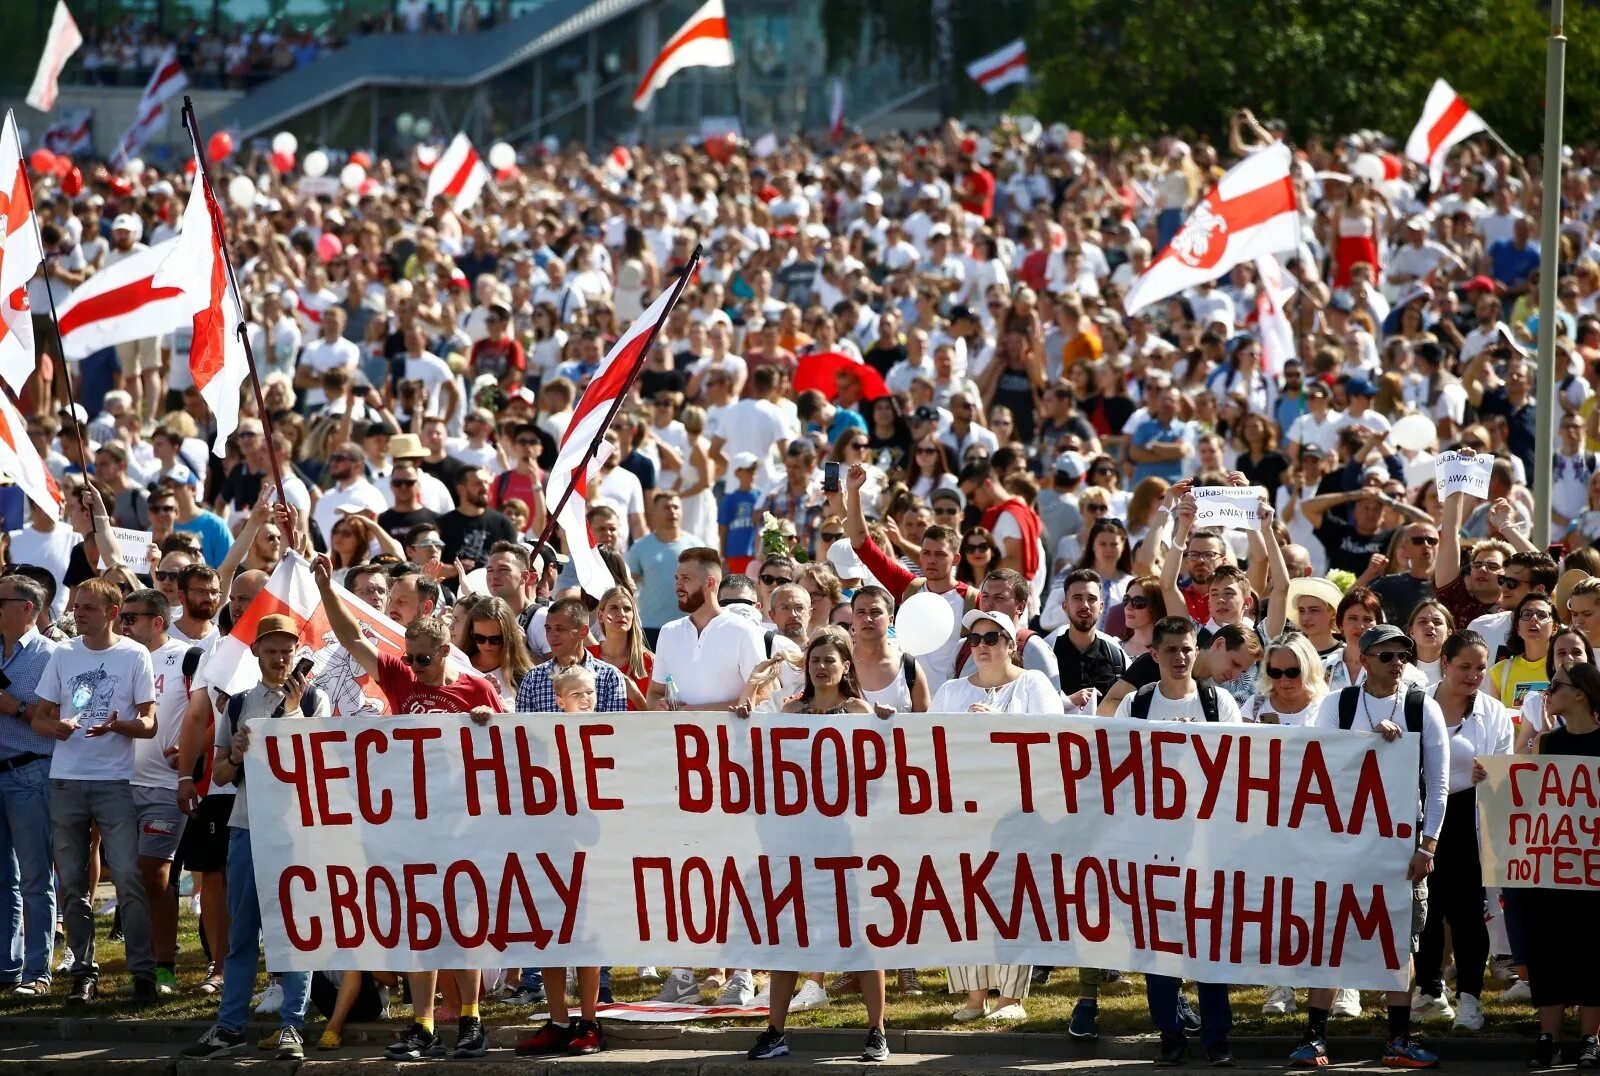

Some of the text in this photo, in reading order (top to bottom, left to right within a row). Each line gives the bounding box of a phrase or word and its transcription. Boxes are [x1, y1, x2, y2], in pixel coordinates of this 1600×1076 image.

[1438, 479, 1445, 489] GO
[1448, 474, 1473, 484] AWAY
[1194, 488, 1252, 498] Lukashenko
[1198, 508, 1254, 520] GO AWAY !!!
[122, 555, 139, 564] WAY
[265, 724, 1413, 839] ЧЕСТНЫЕ ВЫБОРЫ. ТРИБУНАЛ.
[1509, 763, 1600, 808] ГАА
[278, 851, 1401, 970] СВОБОДУ ПОЛИТЗАКЛЮЧЁННЫМ
